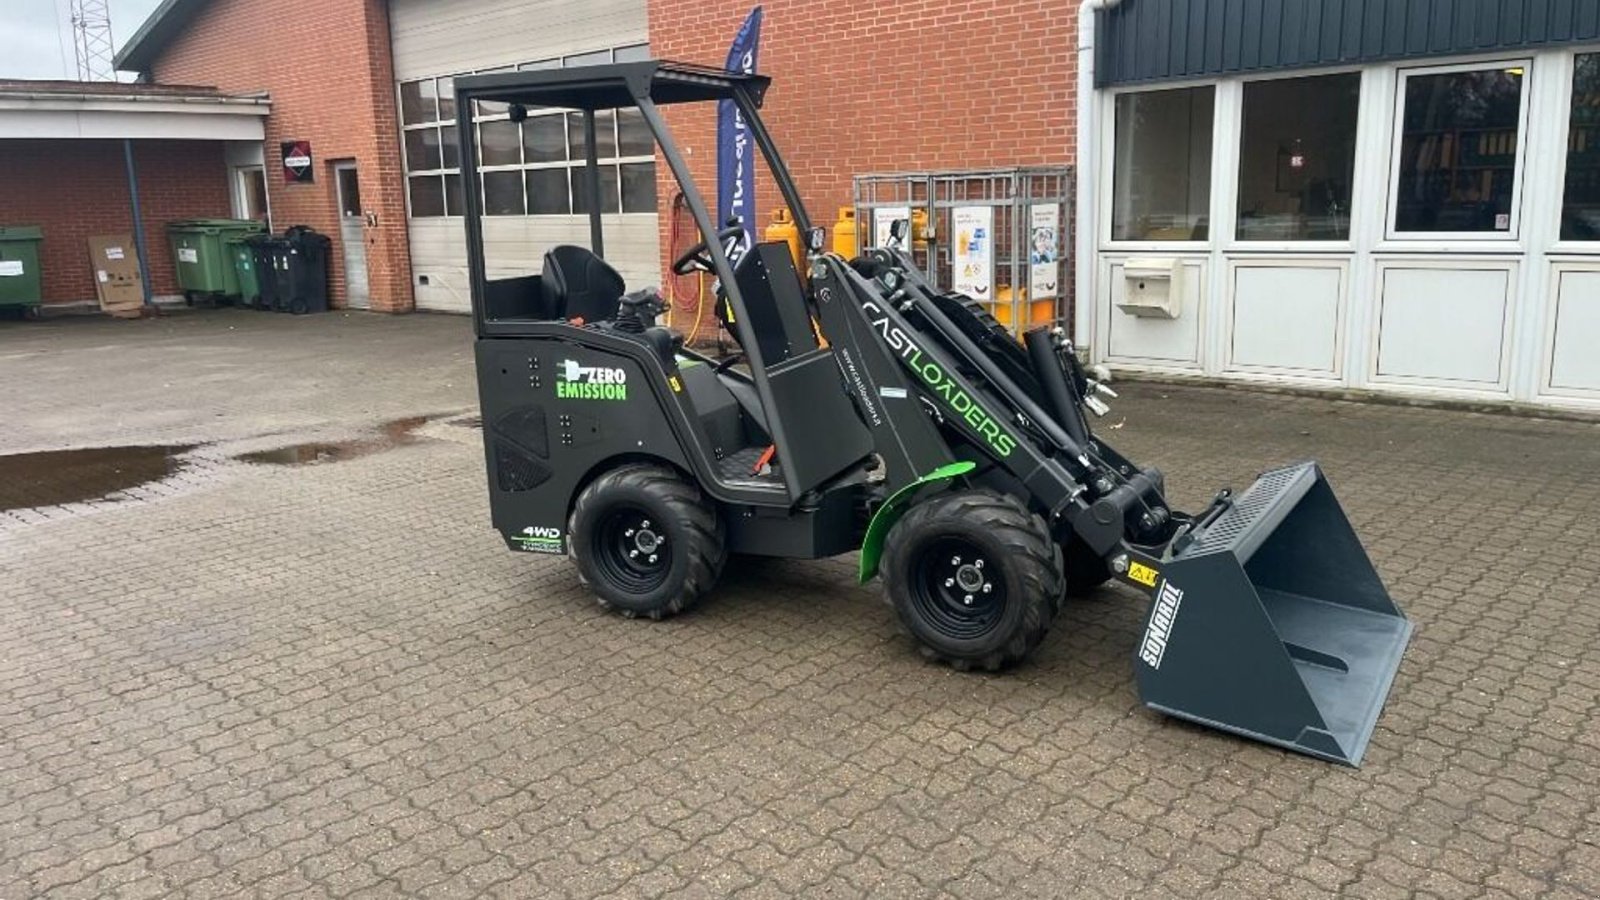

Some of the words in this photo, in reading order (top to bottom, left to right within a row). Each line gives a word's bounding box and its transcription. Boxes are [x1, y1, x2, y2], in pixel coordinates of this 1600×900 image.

[587, 367, 627, 385] ZERO
[863, 301, 1017, 457] CASTLOADERS
[556, 381, 627, 401] EMISSION
[523, 526, 561, 539] 4WD
[1141, 581, 1182, 668] SONAROL
